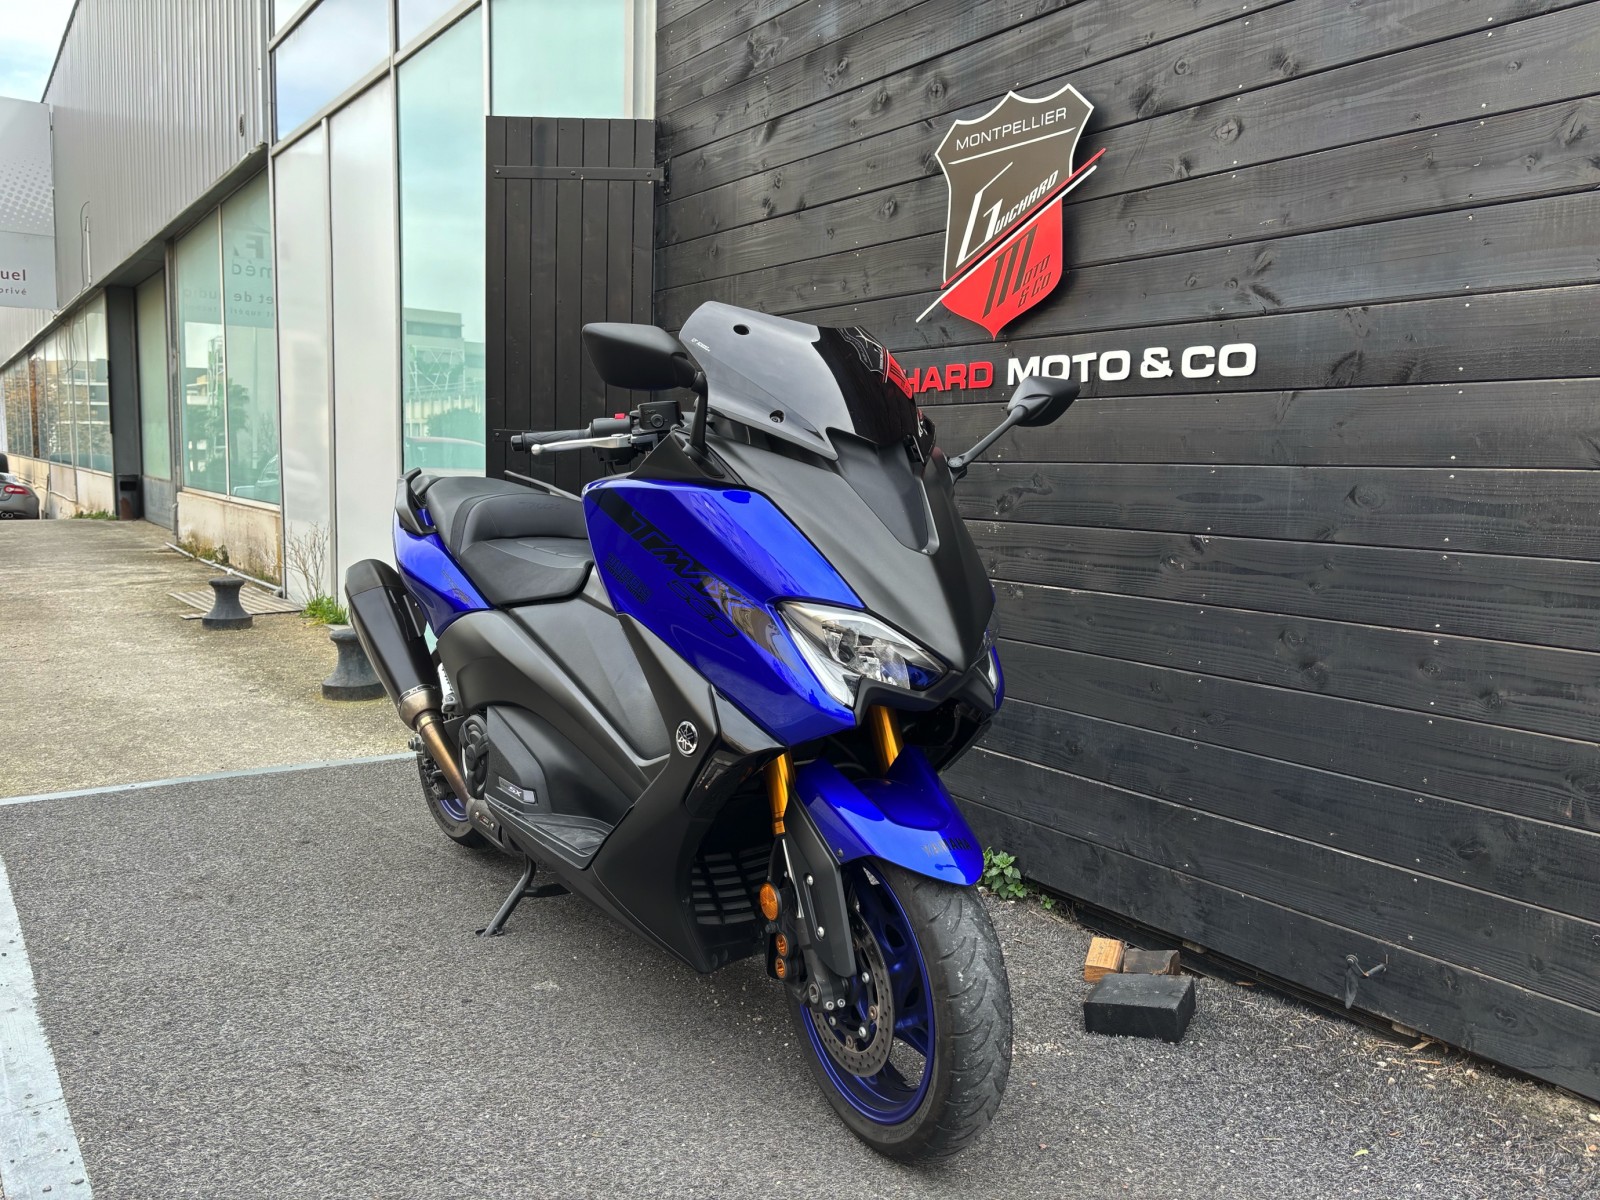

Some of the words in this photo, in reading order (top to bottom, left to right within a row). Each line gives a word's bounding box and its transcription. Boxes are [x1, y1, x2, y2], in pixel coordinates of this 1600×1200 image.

[956, 107, 1067, 151] MONTPELLIER
[0, 269, 26, 281] uel
[904, 361, 994, 394] HARD
[1007, 349, 1131, 386] MOTO
[508, 786, 522, 797] SX
[920, 837, 972, 858] YAMAHA
